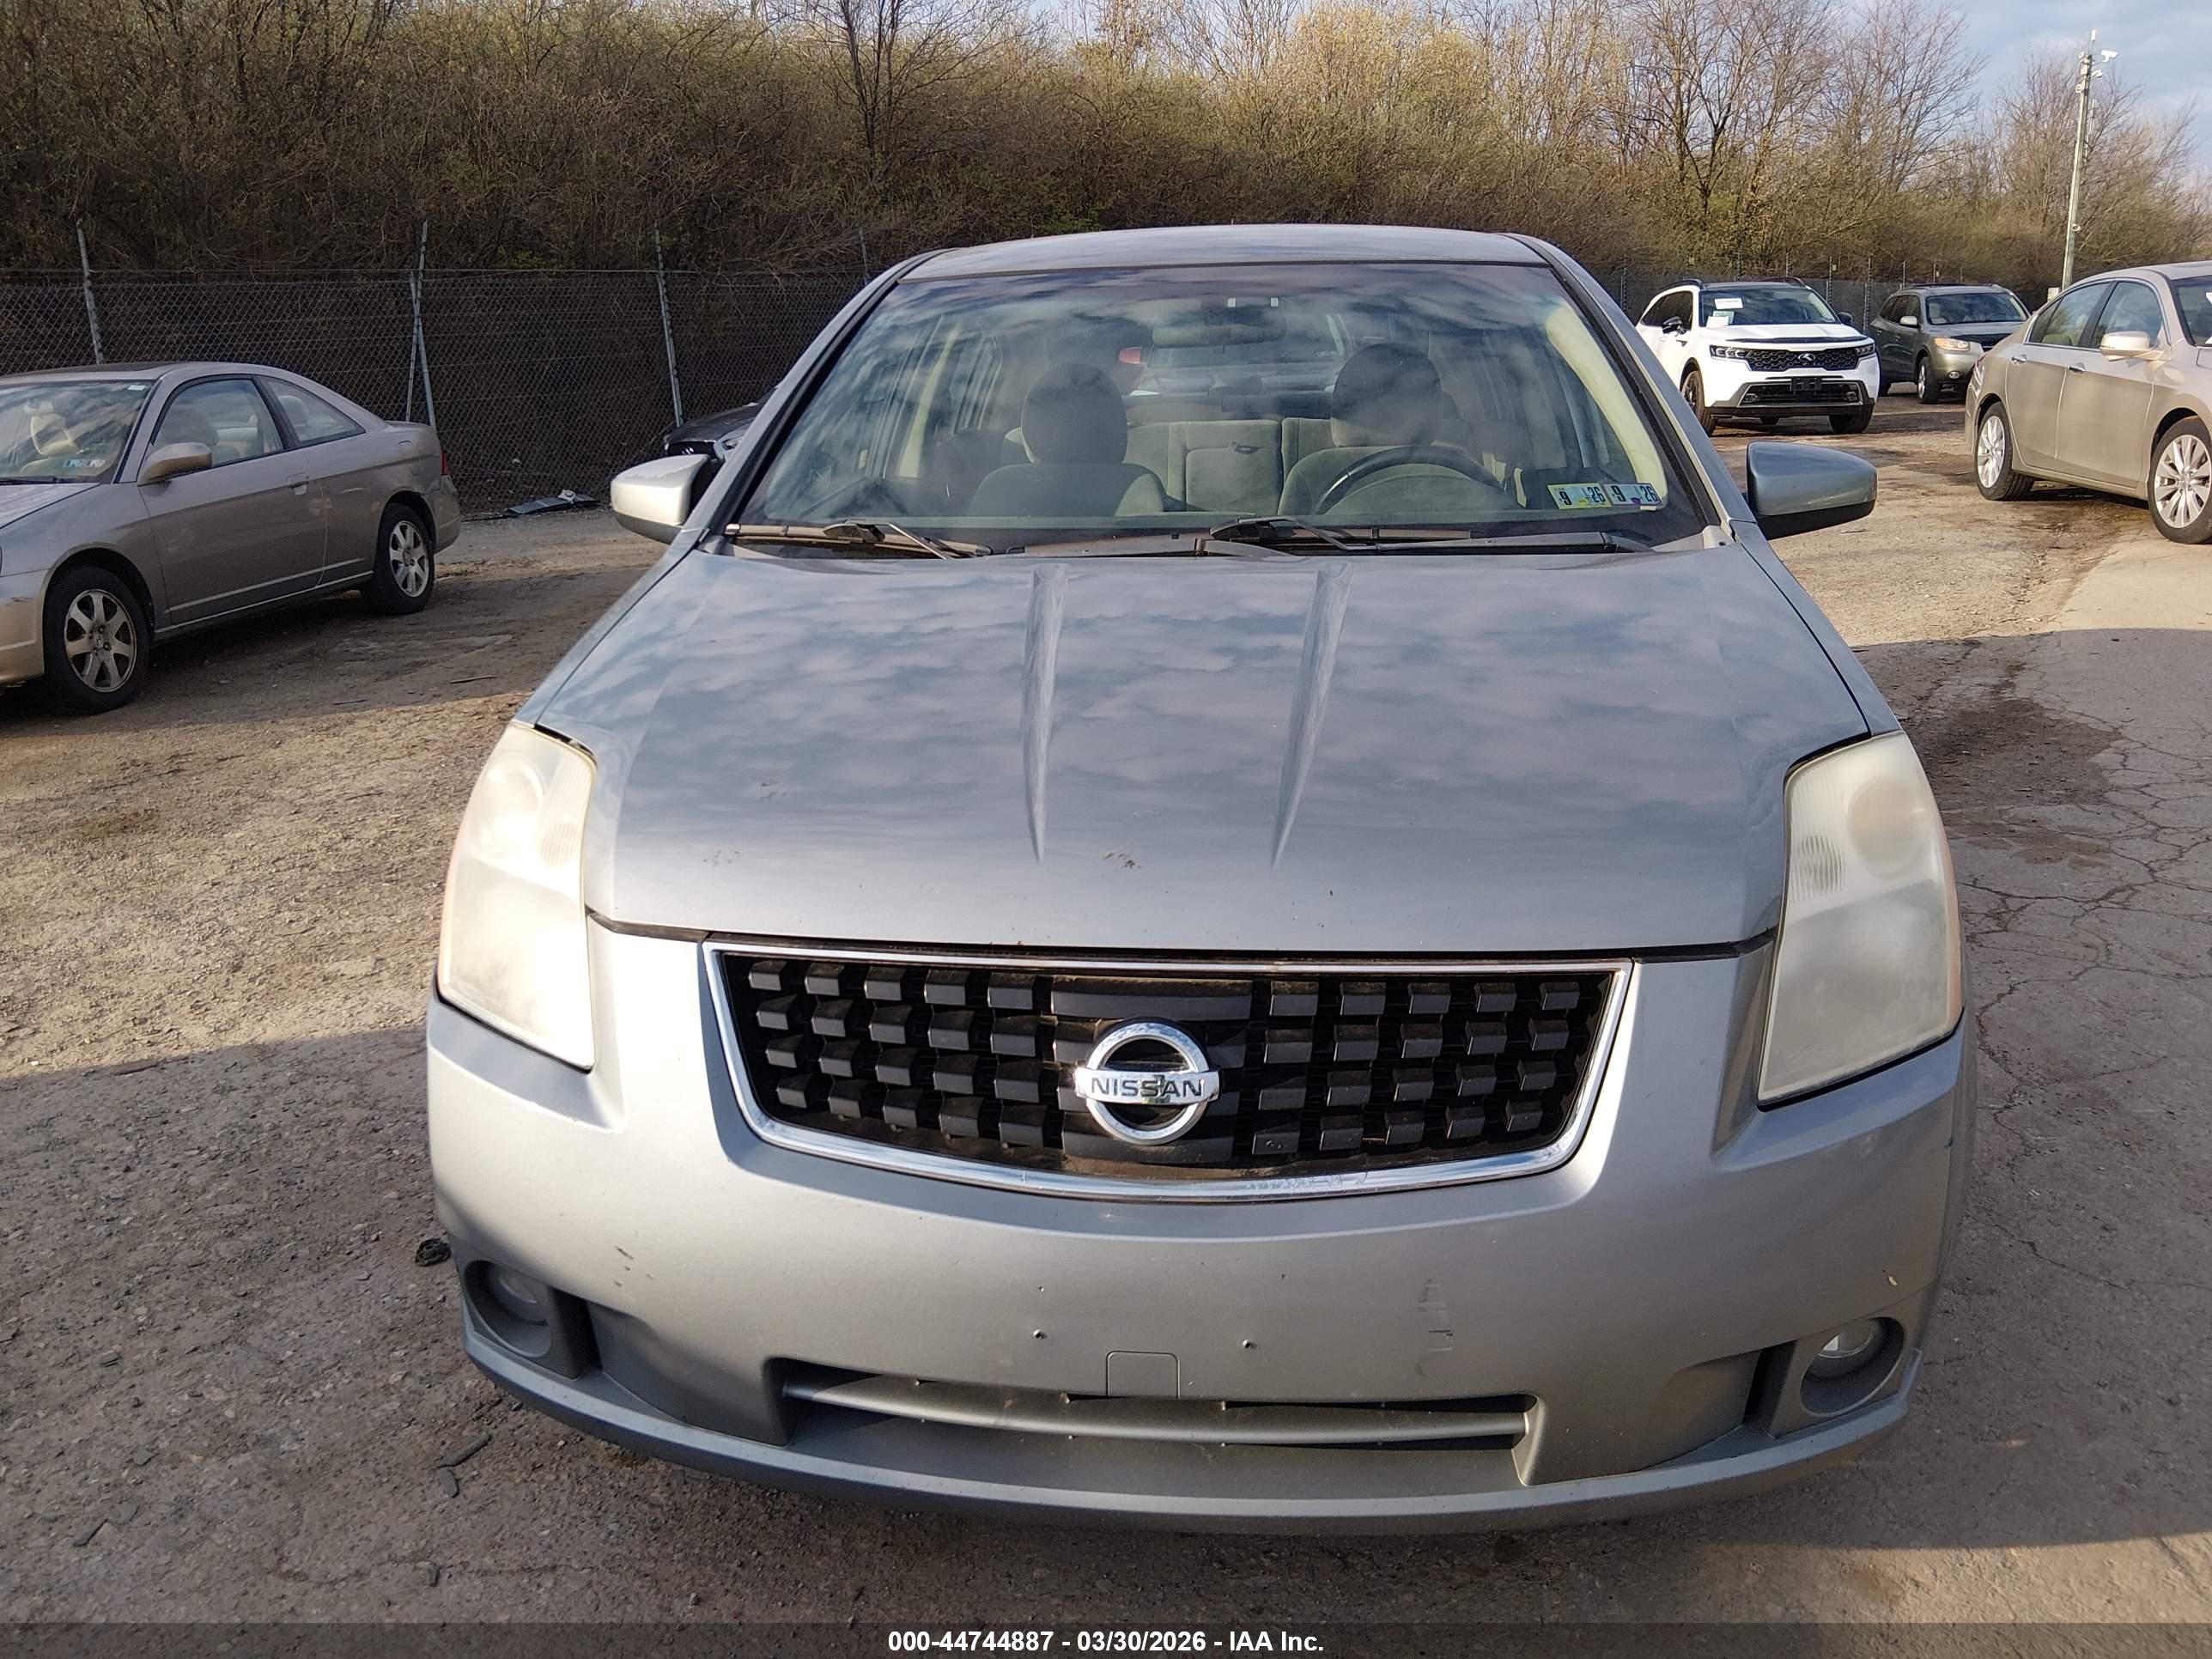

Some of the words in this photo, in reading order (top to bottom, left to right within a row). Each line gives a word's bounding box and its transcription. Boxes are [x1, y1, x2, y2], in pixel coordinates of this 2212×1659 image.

[1559, 491, 1572, 506] 9
[1586, 486, 1606, 503] 26
[1611, 485, 1626, 502] 9
[1639, 485, 1658, 502] 26
[1091, 1076, 1203, 1097] NISSAN
